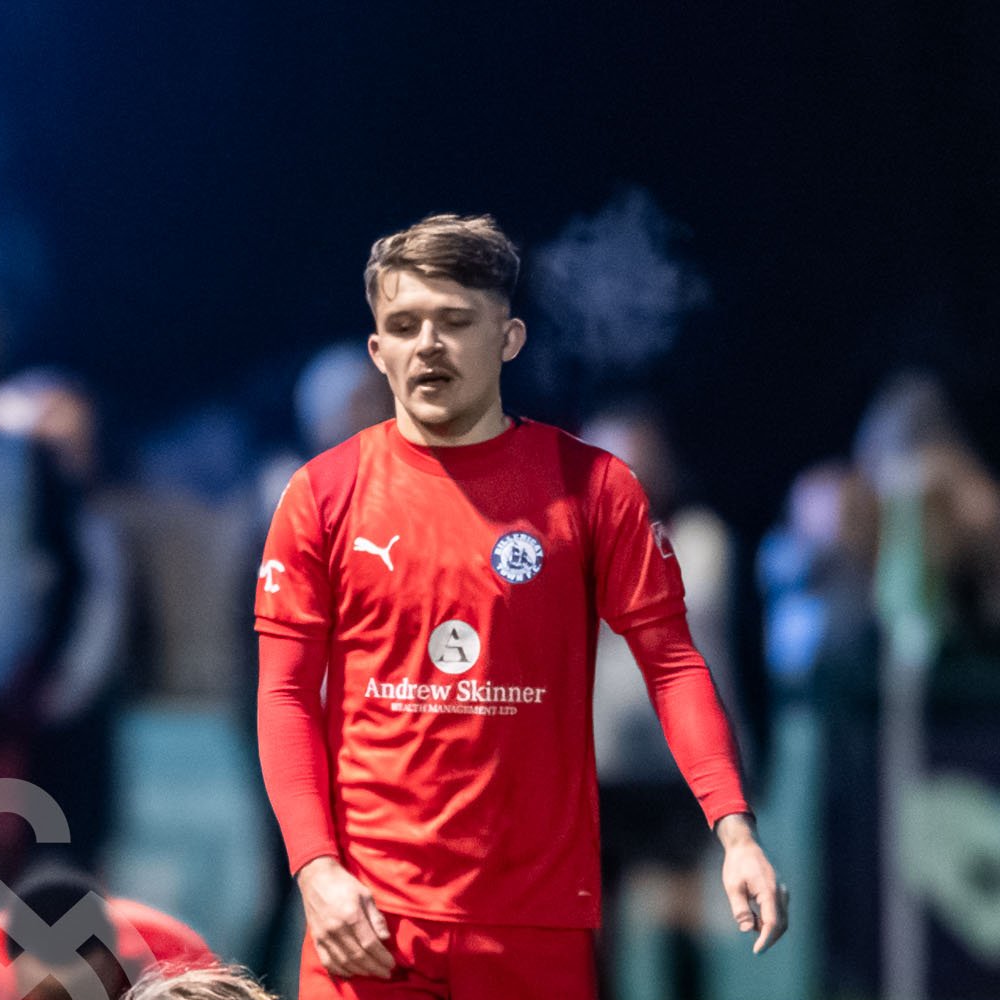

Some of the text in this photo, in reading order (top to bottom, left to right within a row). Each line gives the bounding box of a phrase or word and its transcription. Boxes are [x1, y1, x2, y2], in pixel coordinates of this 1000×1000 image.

[438, 627, 471, 663] A
[364, 677, 547, 703] Andrew Skinner
[427, 703, 497, 716] MANAGEMENT
[500, 706, 518, 716] LTD
